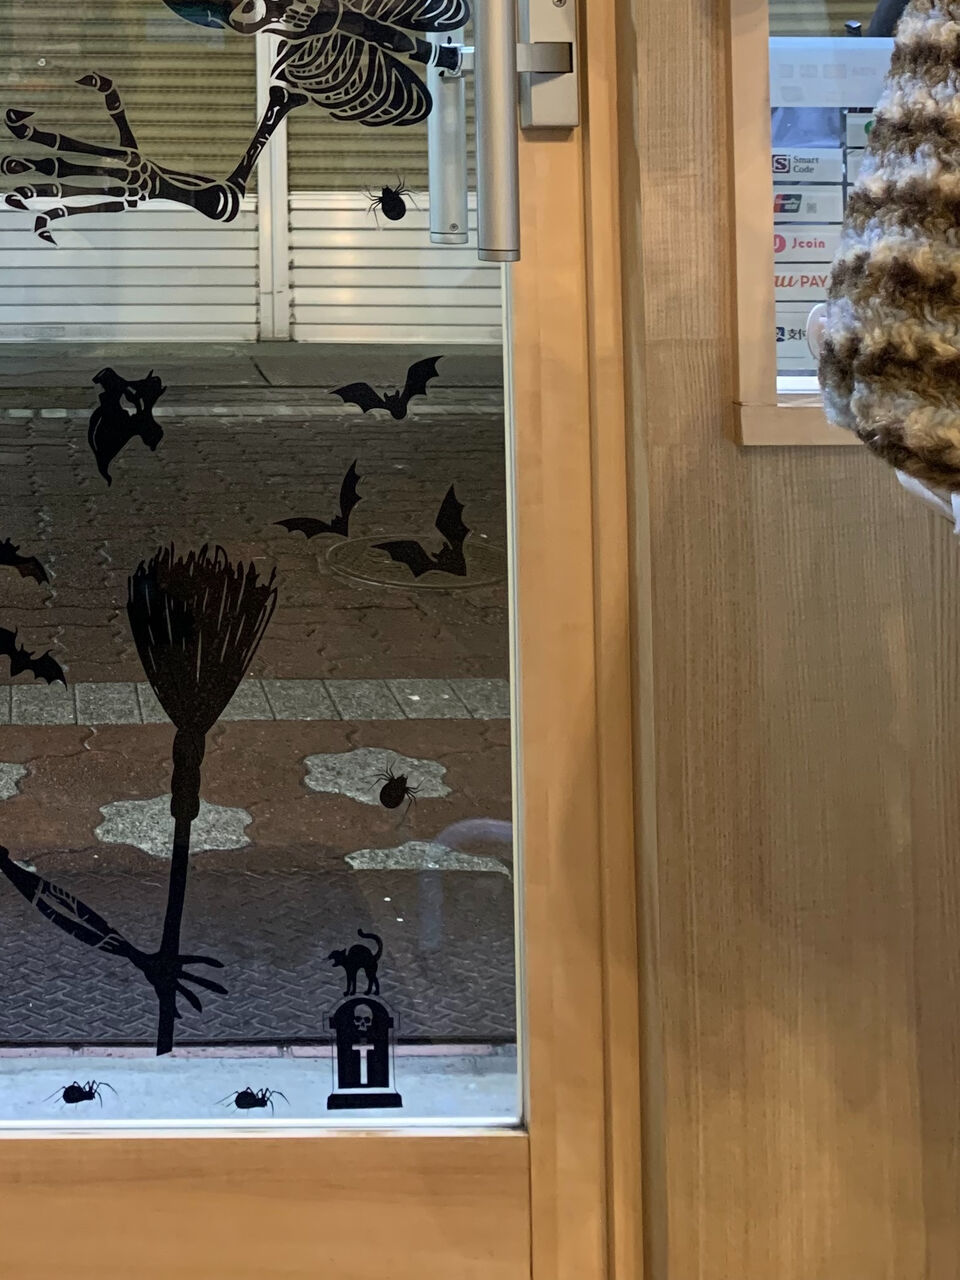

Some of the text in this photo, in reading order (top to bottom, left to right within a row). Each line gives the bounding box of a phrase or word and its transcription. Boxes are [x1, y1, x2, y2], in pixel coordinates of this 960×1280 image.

[793, 155, 819, 163] Smart
[793, 164, 815, 174] Code
[792, 238, 826, 249] Jcoin
[800, 276, 828, 287] PAY
